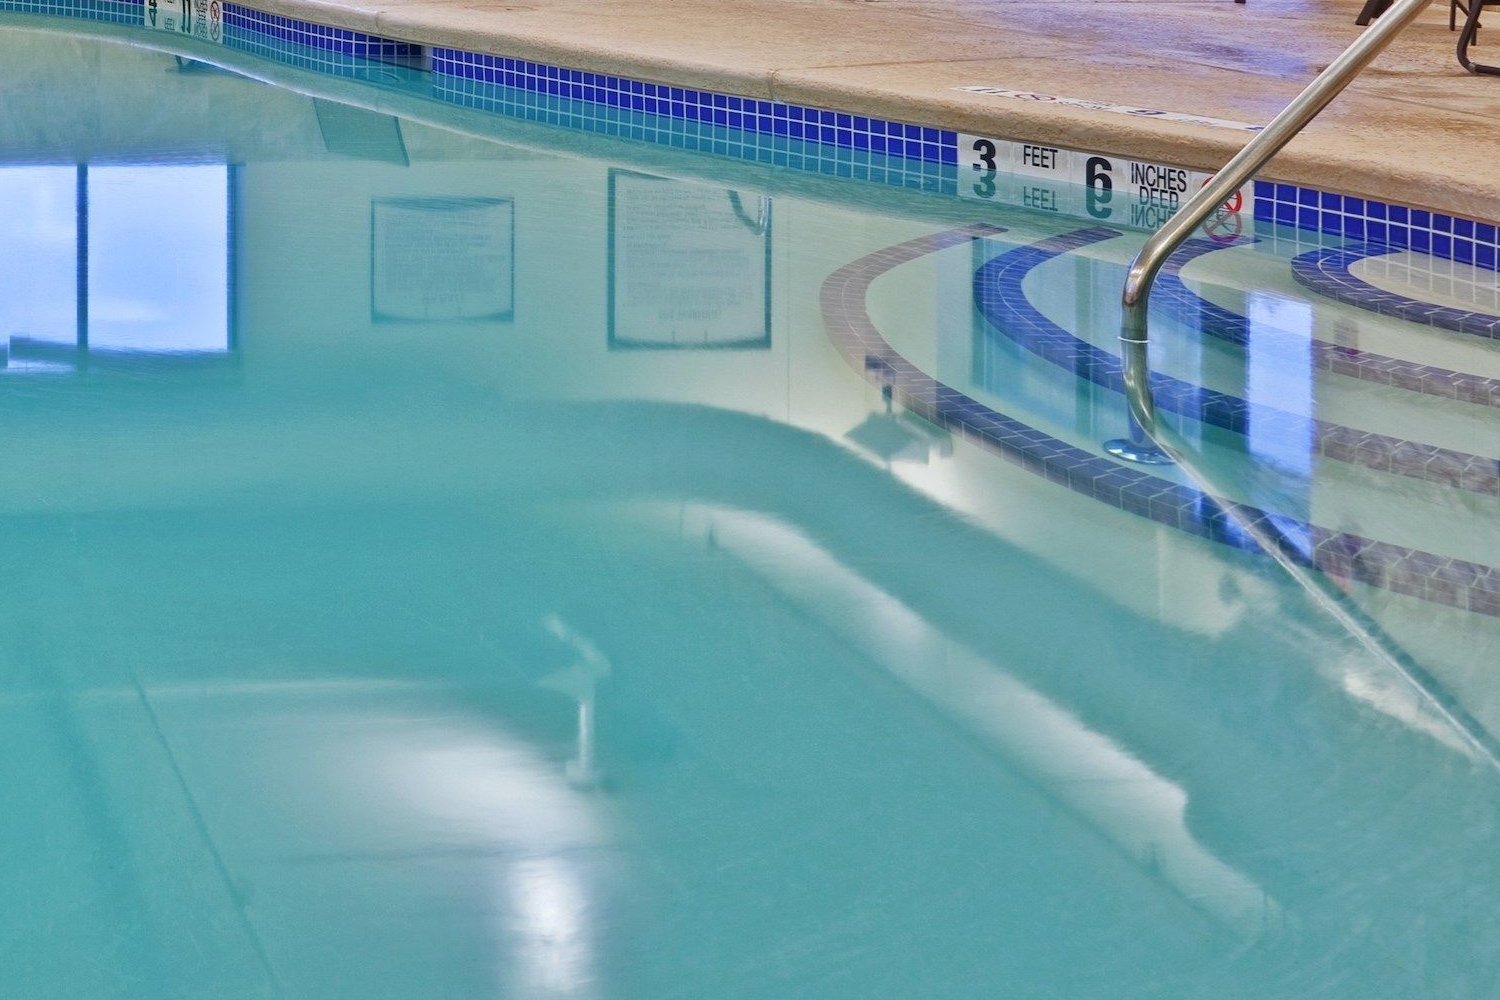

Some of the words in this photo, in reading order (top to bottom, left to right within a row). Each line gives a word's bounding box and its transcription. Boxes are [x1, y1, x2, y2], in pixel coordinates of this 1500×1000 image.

[1023, 145, 1058, 170] FEET
[1086, 156, 1112, 192] 6
[1131, 163, 1187, 193] INCHES
